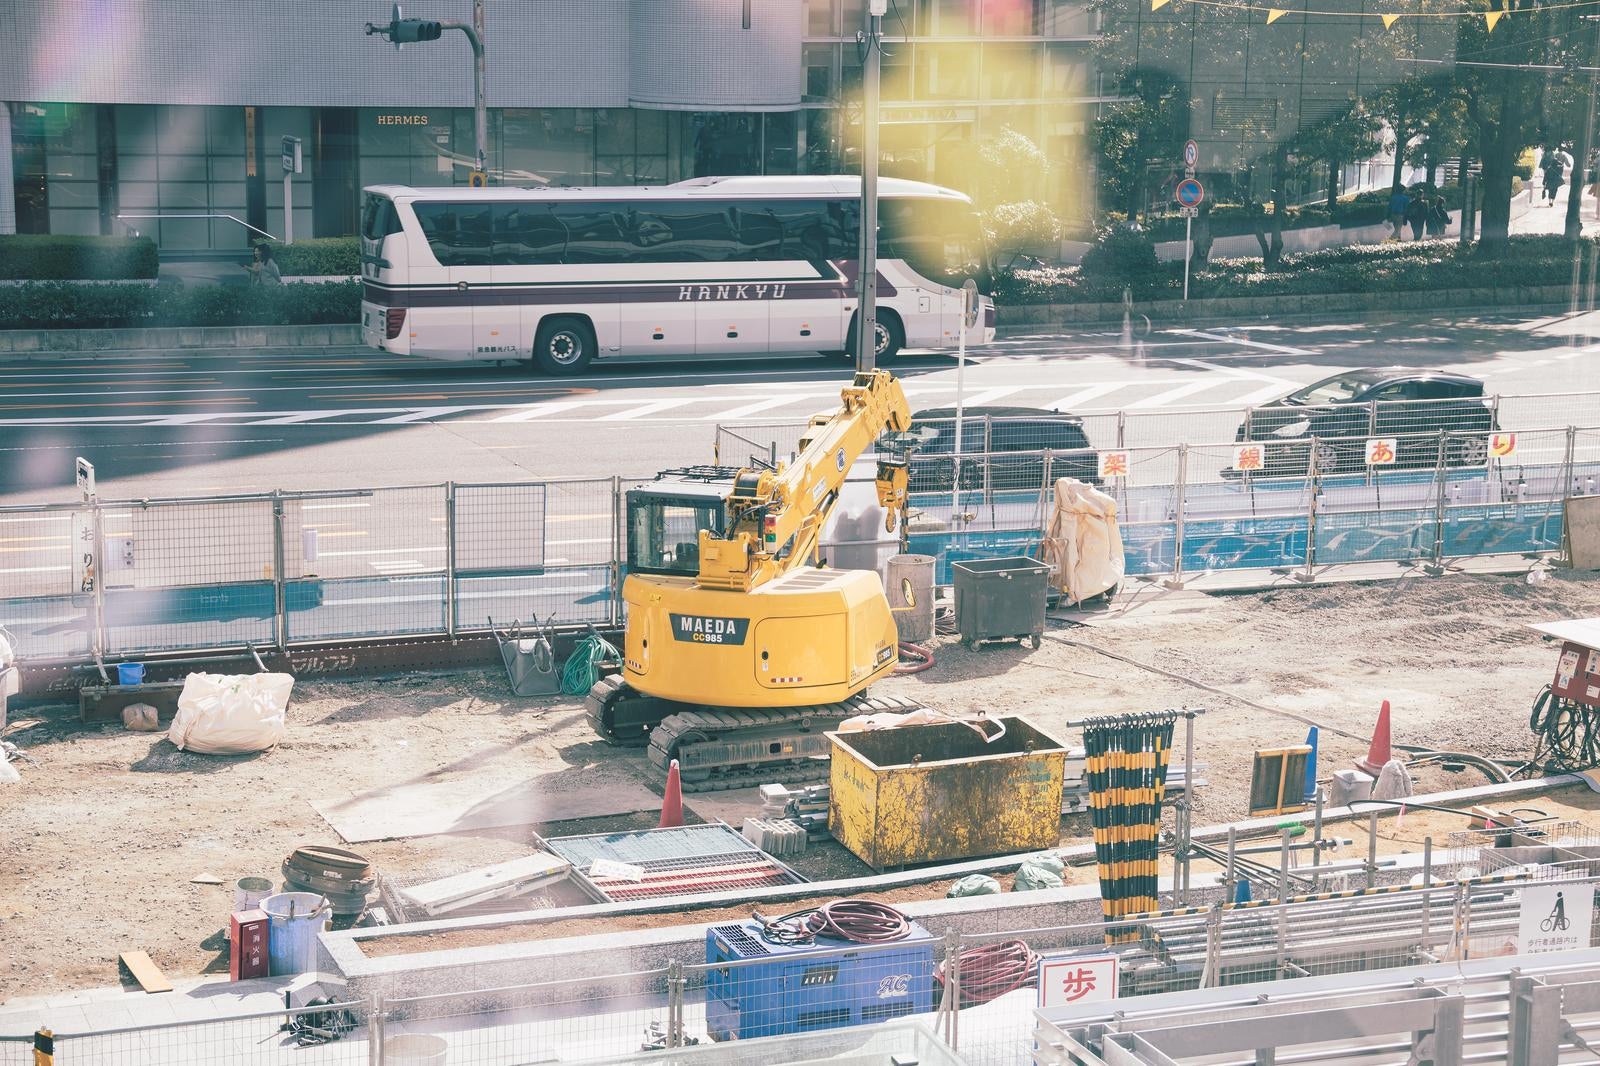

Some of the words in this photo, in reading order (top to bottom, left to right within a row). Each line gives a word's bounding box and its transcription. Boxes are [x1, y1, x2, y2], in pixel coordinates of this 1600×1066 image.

[678, 284, 787, 300] HANKYU
[1370, 441, 1393, 463] あ
[1492, 433, 1516, 456] り
[1103, 453, 1127, 475] 架
[1238, 447, 1261, 469] 線
[681, 616, 736, 634] MAEDA
[693, 632, 723, 643] CC985
[1062, 967, 1097, 1002] 歩
